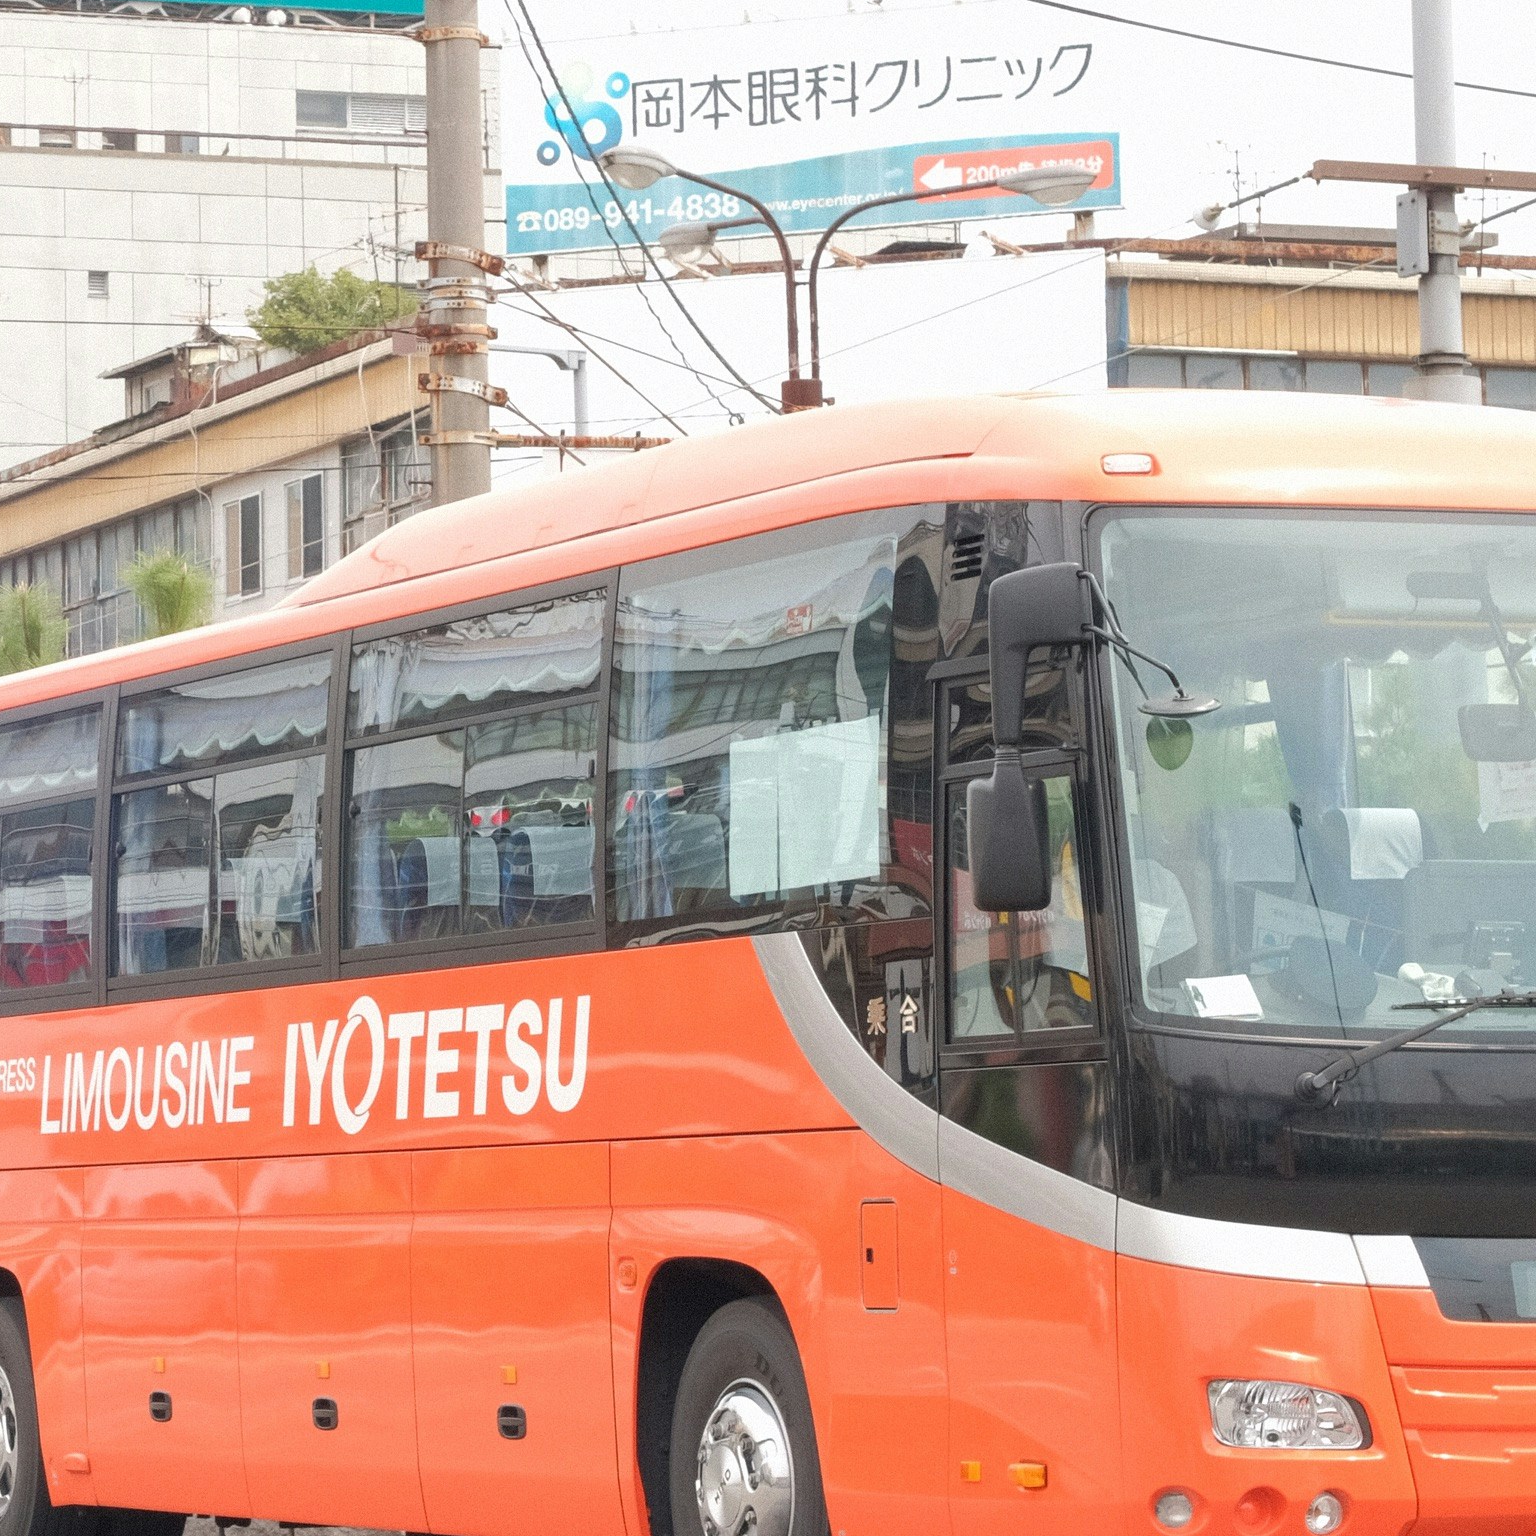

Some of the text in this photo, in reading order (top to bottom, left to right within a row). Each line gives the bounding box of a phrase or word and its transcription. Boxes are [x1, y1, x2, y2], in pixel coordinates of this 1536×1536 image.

[631, 43, 1093, 137] 岡本眼科クリニック
[544, 193, 740, 232] 089-941-4838
[40, 1035, 255, 1135] LIMOUSINE
[282, 995, 591, 1135] IYOTETSU
